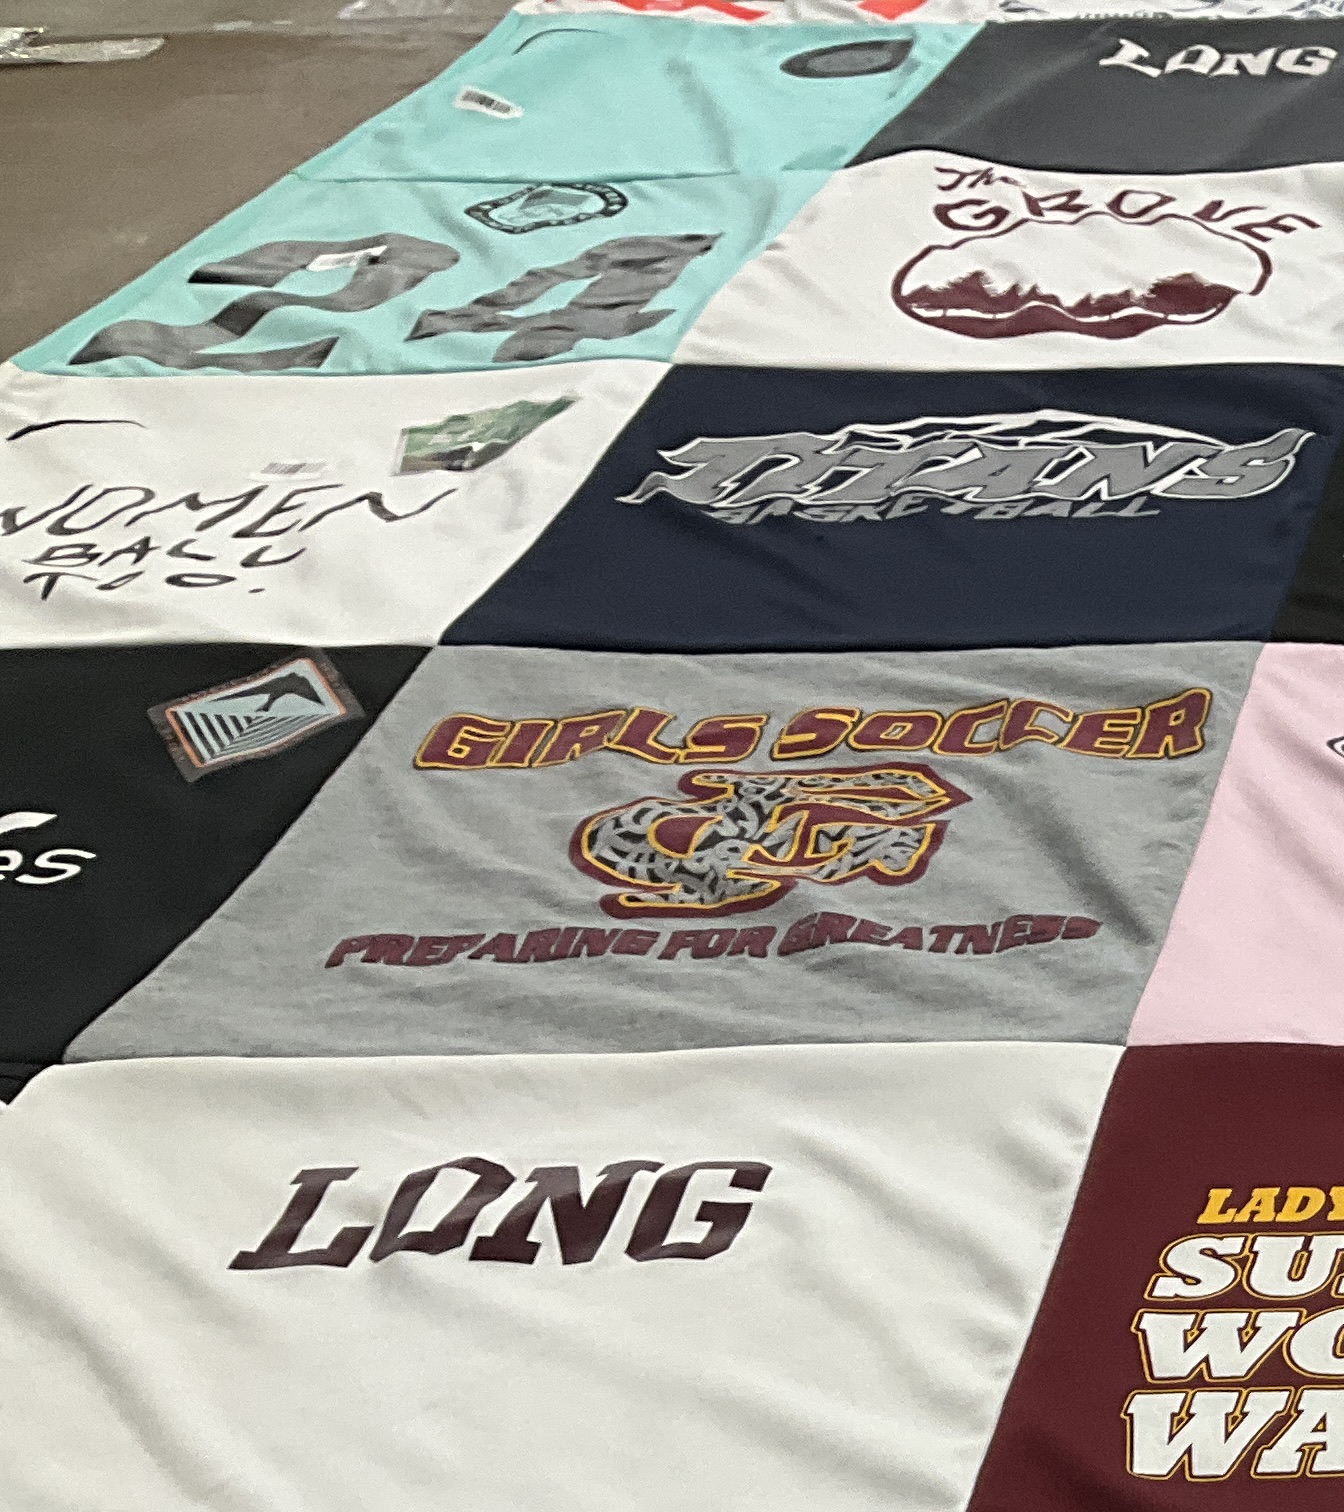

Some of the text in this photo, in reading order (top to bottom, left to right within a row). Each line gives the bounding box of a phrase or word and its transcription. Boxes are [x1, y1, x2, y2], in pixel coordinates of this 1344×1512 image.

[1099, 38, 1338, 78] LONG
[935, 167, 1026, 190] The
[934, 189, 1323, 242] GROVE
[412, 687, 1215, 771] GIRLS SOCCER
[324, 911, 1105, 969] PREPARING FOR GREATNESS
[227, 1156, 773, 1271] LONG
